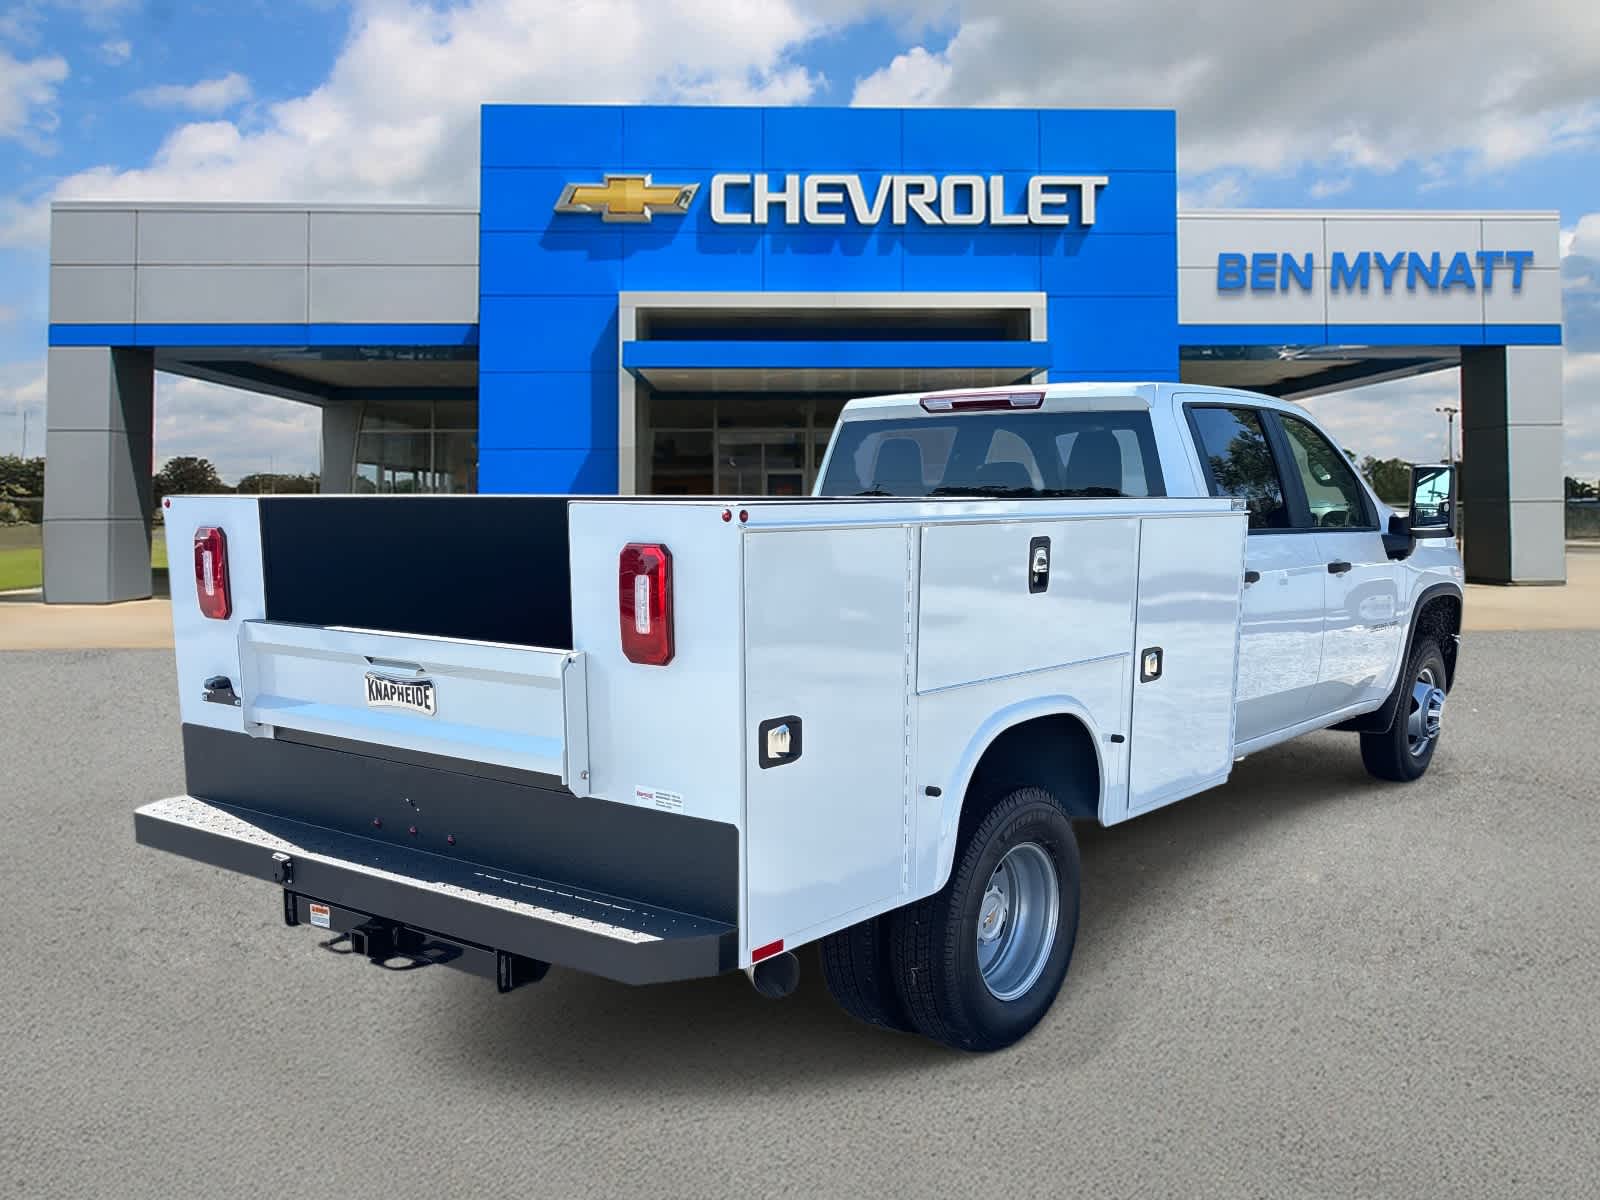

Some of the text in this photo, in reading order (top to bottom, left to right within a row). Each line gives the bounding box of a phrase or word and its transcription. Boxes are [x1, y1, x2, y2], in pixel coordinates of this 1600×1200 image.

[711, 173, 1109, 225] CHEVROLET
[1217, 250, 1534, 290] BEN MYNATT
[367, 678, 431, 711] KNAPHEIDE
